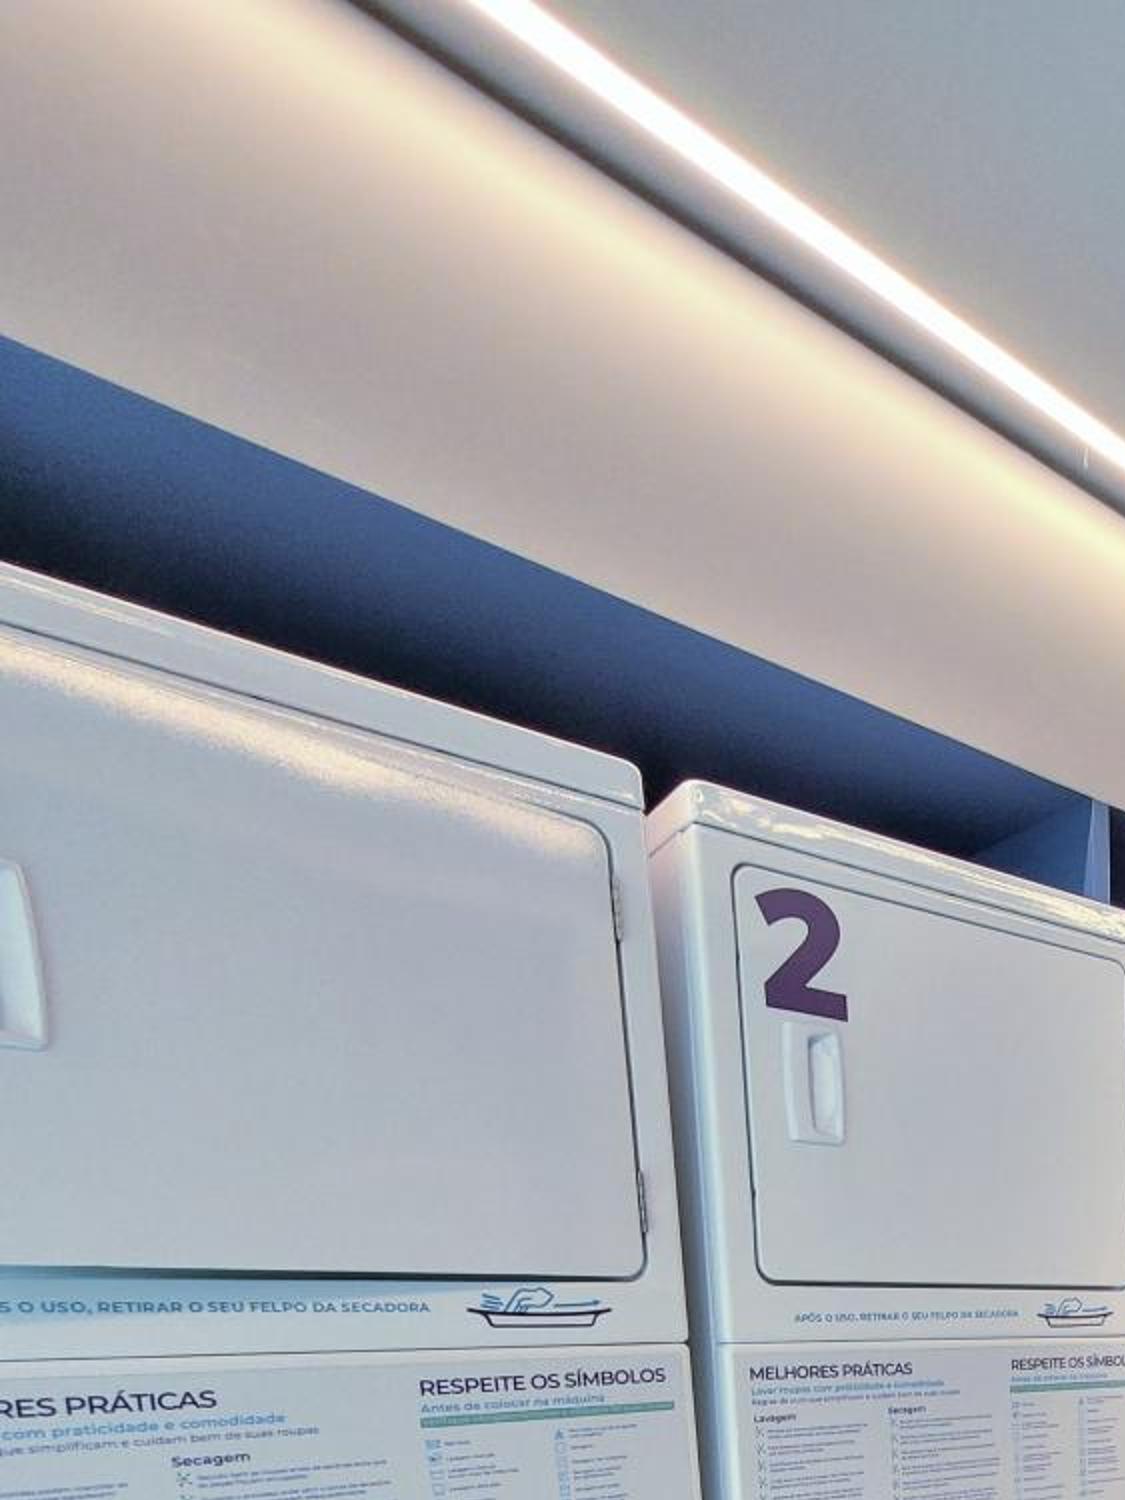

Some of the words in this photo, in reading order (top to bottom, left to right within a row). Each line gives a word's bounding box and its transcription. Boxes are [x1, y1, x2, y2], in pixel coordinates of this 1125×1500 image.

[754, 888, 848, 1022] 2
[17, 1301, 35, 1313] O
[41, 1301, 93, 1315] USO,
[98, 1301, 183, 1313] RETIRAR
[188, 1301, 204, 1313] O
[207, 1301, 245, 1313] SEU
[249, 1301, 307, 1313] FELPO
[313, 1301, 338, 1313] DA
[341, 1300, 431, 1313] SECADORA
[750, 1364, 839, 1381] MELHORES
[843, 1361, 913, 1377] PRÁTICAS
[1011, 1357, 1066, 1370] RESPEITE
[1068, 1356, 1084, 1368] OS
[419, 1375, 525, 1396] RESPEITE
[530, 1373, 560, 1390] OS
[564, 1367, 667, 1389] SÍMBOLOS
[65, 1390, 218, 1415] PRÁTICAS
[420, 1402, 462, 1413] Antes
[2, 1428, 48, 1440] com
[52, 1421, 159, 1439] praticidade
[164, 1421, 175, 1430] e
[180, 1412, 286, 1430] comodidade
[754, 1414, 797, 1424] Lavagem
[28, 1437, 118, 1455] simplificam
[133, 1434, 186, 1447] cuidam
[190, 1430, 220, 1442] bem
[224, 1429, 241, 1440] de
[277, 1425, 320, 1439] roupas
[171, 1453, 250, 1468] Secagem
